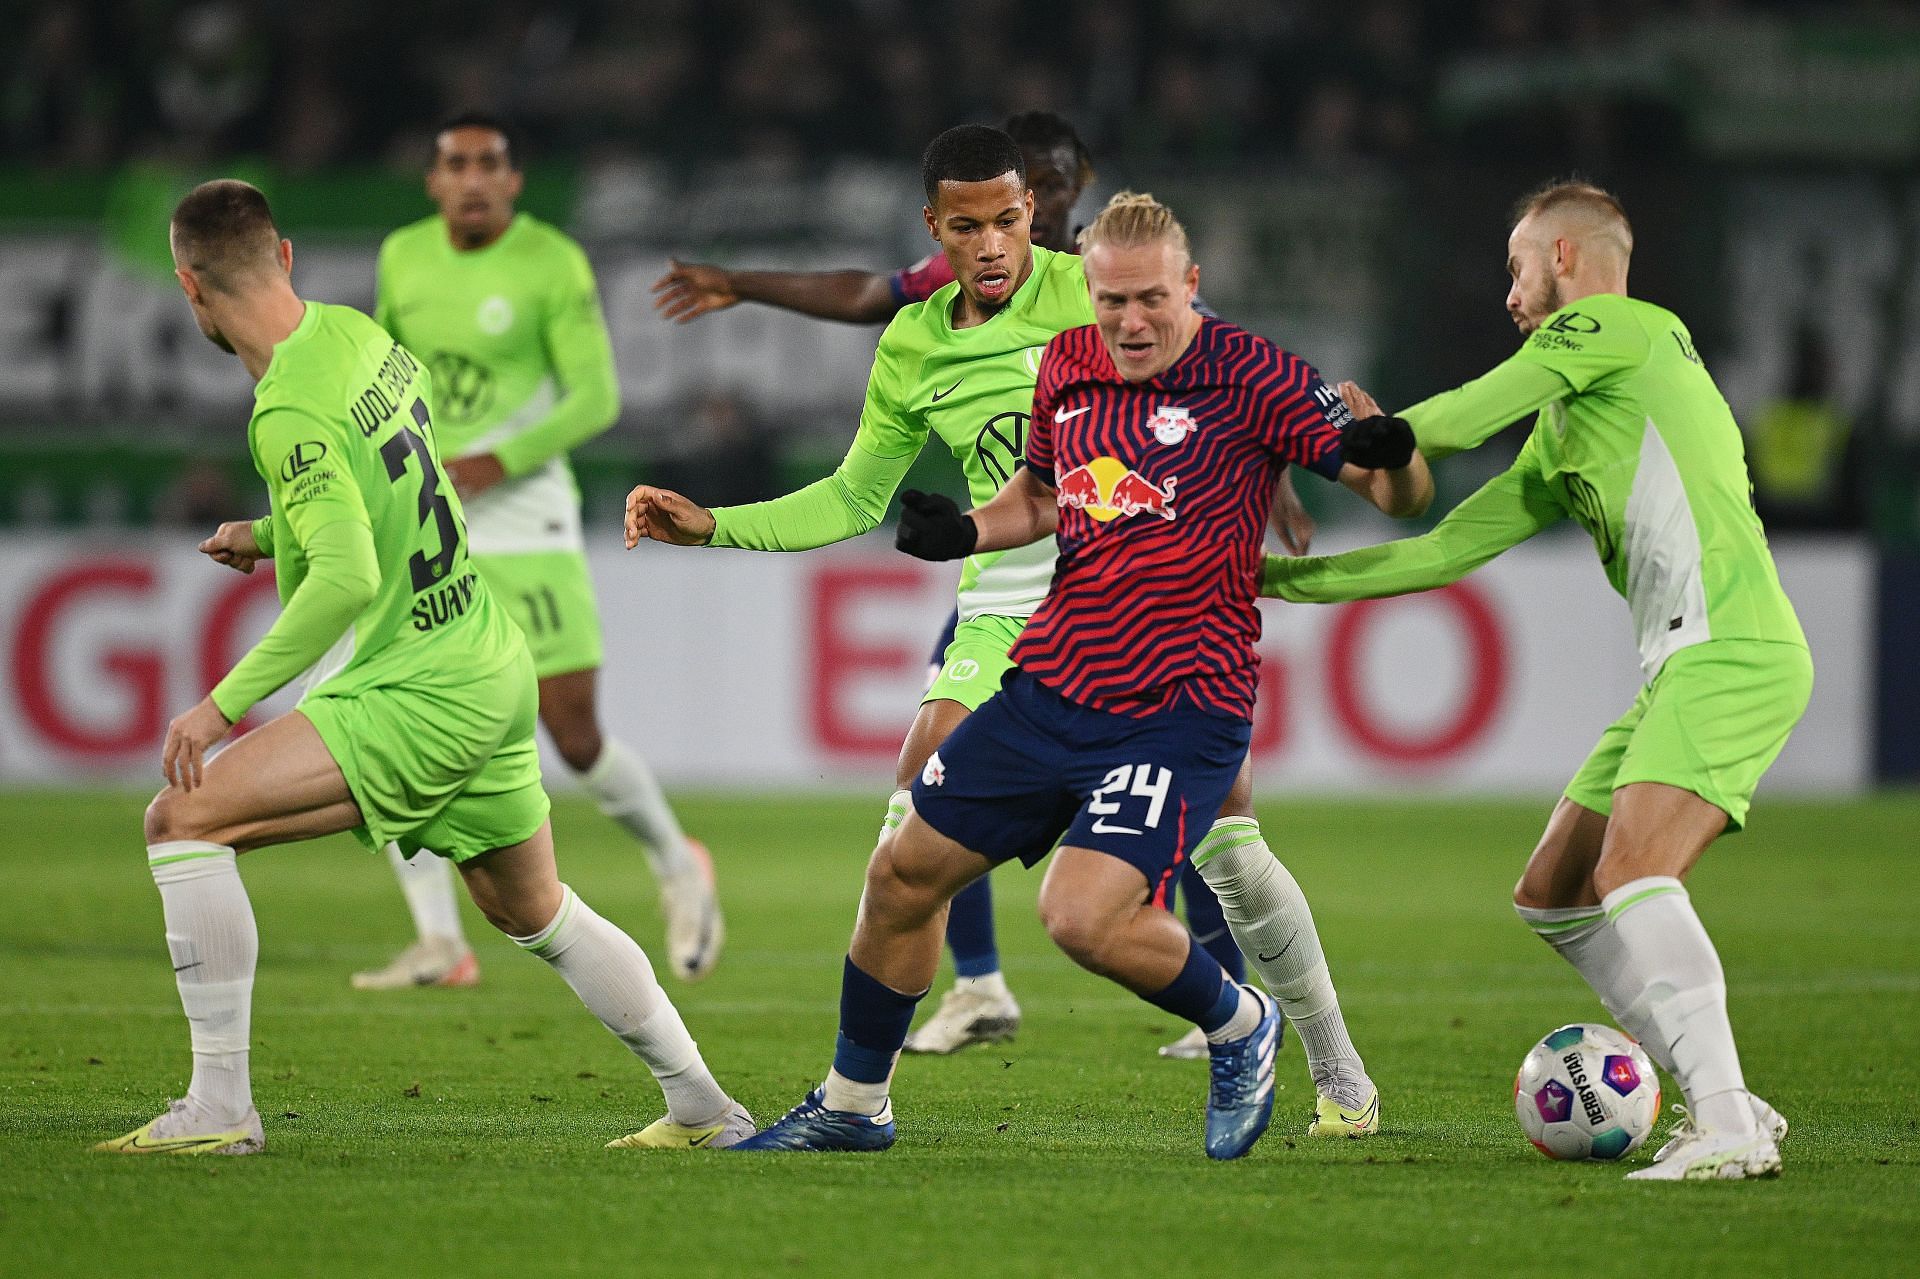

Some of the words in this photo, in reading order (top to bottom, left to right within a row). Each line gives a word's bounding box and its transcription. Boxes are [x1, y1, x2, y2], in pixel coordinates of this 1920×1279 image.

[522, 583, 562, 636] 11
[1087, 763, 1173, 829] 24
[1562, 1051, 1606, 1127] DERBYSTAR
